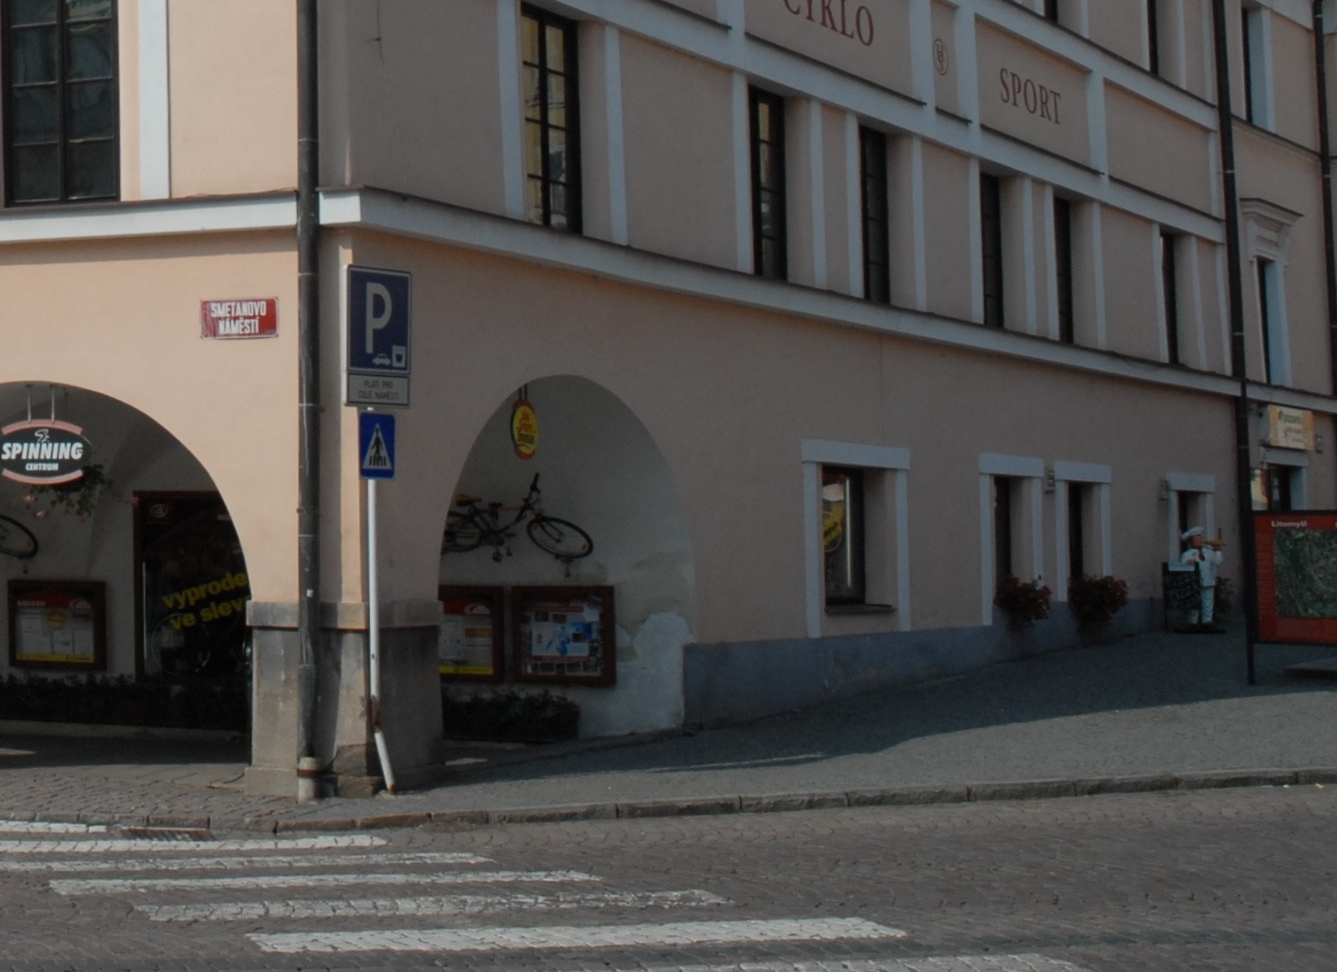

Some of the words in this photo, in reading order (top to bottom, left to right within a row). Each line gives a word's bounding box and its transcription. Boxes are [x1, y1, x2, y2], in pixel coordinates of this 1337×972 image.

[999, 67, 1062, 125] SPORT
[210, 301, 267, 318] SMETANOVO
[365, 281, 393, 355] P
[218, 316, 260, 335] NÁMĚSTÍ
[1, 442, 84, 461] SPINNING
[25, 462, 59, 471] CENTRUM
[162, 572, 249, 610] vyprode
[169, 613, 197, 631] ve
[199, 596, 247, 622] slev
